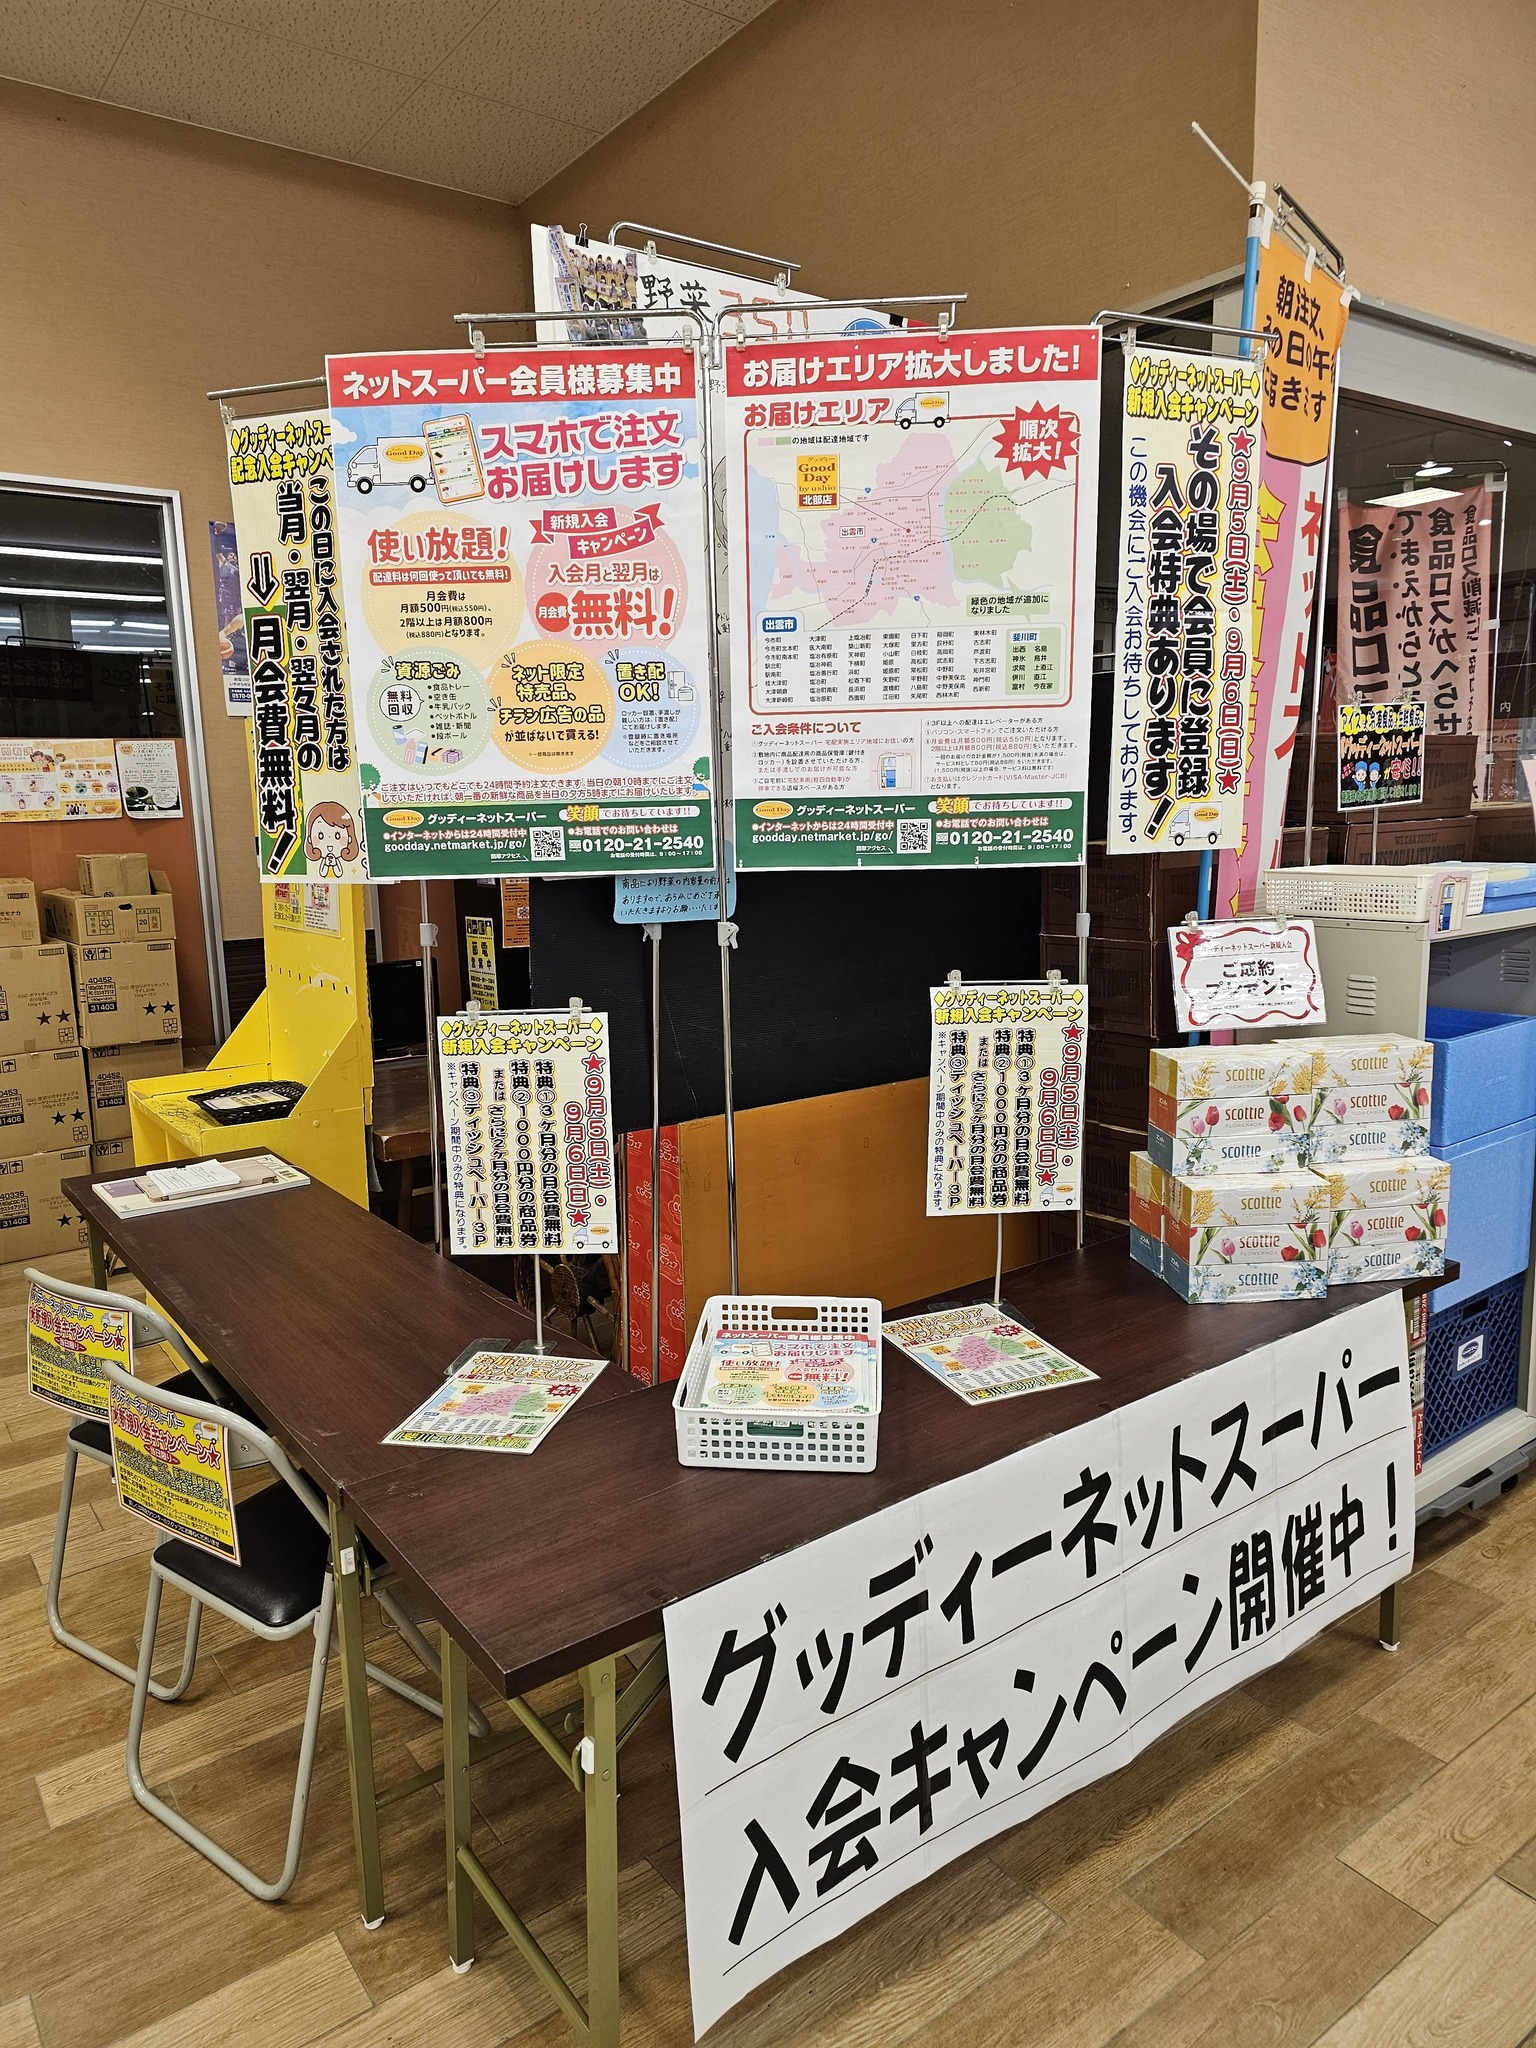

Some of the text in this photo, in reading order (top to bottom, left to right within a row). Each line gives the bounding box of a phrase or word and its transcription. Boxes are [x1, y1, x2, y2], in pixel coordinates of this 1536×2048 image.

[743, 343, 1080, 388] お届けエリア拡大しました!
[343, 362, 681, 399] ネットスーパー会員様募集中
[1139, 358, 1251, 396] グッディーネットスーパー
[744, 397, 891, 428] お届けエリア
[1127, 388, 1259, 428] 新規入会キャンペーン
[481, 411, 680, 460] スマホで注文
[1019, 419, 1058, 440] 順次
[792, 433, 870, 444] の地域は配達地域です
[1012, 440, 1061, 463] 拡大!
[487, 454, 683, 499] お届けします
[798, 463, 836, 474] Good
[803, 473, 832, 484] Day
[799, 484, 836, 493] by ushio
[803, 495, 832, 506] 北部店
[550, 512, 608, 530] 新規入会
[842, 527, 864, 537] 出雲市
[367, 526, 509, 564] 使い放題!
[576, 527, 647, 555] キャンペーン
[372, 569, 508, 583] 配達料は何回使って頂いても無料!
[548, 562, 660, 583] 入会月と翌月は
[426, 591, 466, 601] 月会費は
[970, 594, 1049, 606] 緑色の地域が追加に
[538, 587, 675, 636] 月会費 無料!
[971, 605, 1010, 614] なりました
[1177, 424, 1221, 798] その場で会員に登録
[275, 480, 322, 772] 当月・翌月・翌々月の
[306, 478, 350, 771] この日に入会された方は
[400, 616, 493, 627] 2階以上は月額800円
[765, 619, 795, 630] 出雲市
[1119, 435, 1148, 843] この機会にご入会お待ちしております。
[1144, 464, 1187, 838] 入会特典あります！
[395, 661, 461, 680] 資源ごみ
[512, 661, 584, 682] ネット限定
[616, 662, 666, 681] 置き配
[433, 683, 470, 691] 食品トレー
[516, 682, 576, 701] 特売品、
[618, 682, 660, 702] OK!
[387, 690, 412, 702] 無料
[388, 704, 413, 715] 回収
[499, 704, 605, 725] チラシ広告の品
[435, 722, 472, 730] 雑誌・新聞
[751, 721, 861, 735] ご入会条件について
[436, 732, 467, 740] 段ボール
[249, 615, 298, 875] 月会費無料！
[797, 803, 916, 816] グッディーネットスーパー
[428, 811, 547, 825] グッディーネットスーパー
[759, 820, 894, 832] インターネットからは24時間受付中
[944, 816, 1049, 829] お電話でのお問い合わせは
[391, 828, 528, 841] インターネットからは24時間受付中
[574, 824, 678, 836] お電話でのお問い合わせは
[752, 830, 893, 843] goodday.netmarket.jp/go/
[949, 828, 1074, 846] 0120-21-2540
[384, 839, 527, 852] goodday.netmarket.jp/go/
[582, 835, 704, 852] 0120-21-2540
[944, 989, 1074, 1007] グッディーネットスーパー
[90, 1003, 115, 1012] 31403
[934, 1007, 1083, 1024] 新規入会キャンペーン
[452, 1019, 592, 1037] グッディーネットスーパー
[441, 1036, 603, 1055] 新規入会キャンペーン
[978, 1036, 989, 1068] または
[1351, 1057, 1389, 1071] scottie
[97, 1072, 121, 1080] 40452
[1226, 1068, 1266, 1082] scottie
[493, 1068, 506, 1101] または
[99, 1097, 124, 1106] 31403
[1350, 1094, 1387, 1109] scottie
[1225, 1107, 1265, 1121] scottie
[1349, 1131, 1387, 1146] scottie
[1222, 1145, 1262, 1159] scottie
[1369, 1178, 1407, 1194] scottie
[1241, 1196, 1282, 1211] scottie
[2, 1217, 28, 1227] 31402
[1367, 1216, 1404, 1232] scottie
[1239, 1234, 1280, 1249] scottie
[1364, 1252, 1401, 1268] scottie
[1238, 1271, 1279, 1287] scottie
[700, 1347, 1400, 1763] グッディーネットスーパー
[727, 1462, 1399, 1947] 入会キャンペーン開催中！
